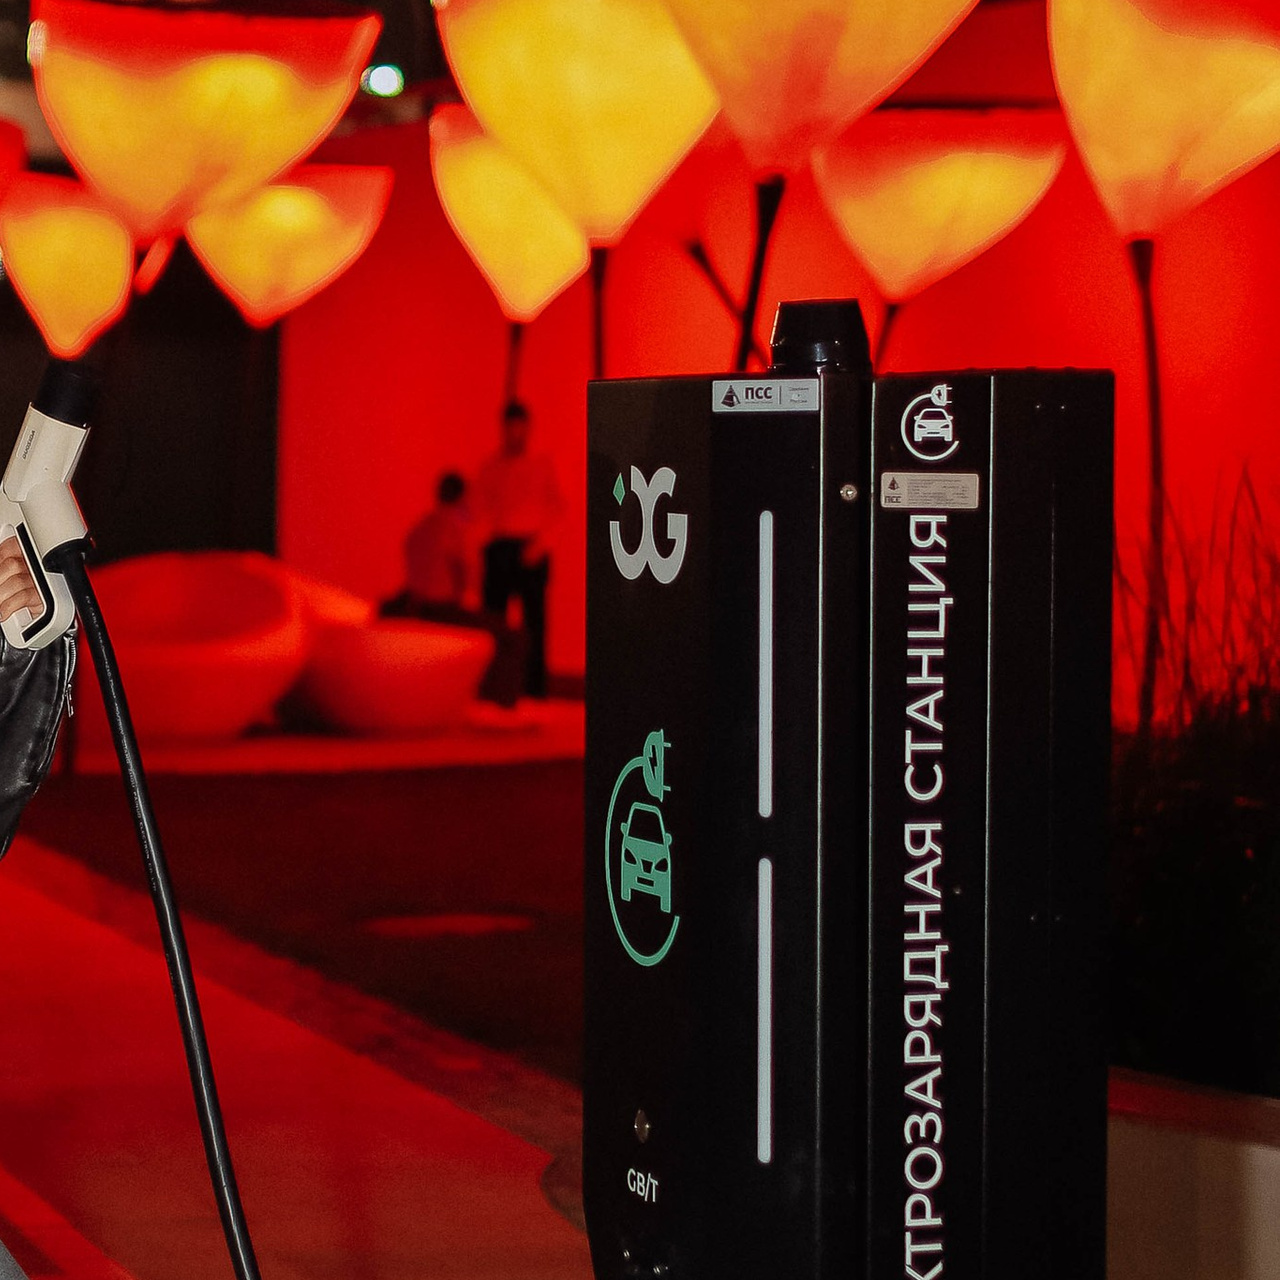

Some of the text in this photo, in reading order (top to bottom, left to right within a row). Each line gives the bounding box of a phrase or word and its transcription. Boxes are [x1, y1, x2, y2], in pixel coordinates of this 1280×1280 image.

[745, 387, 773, 400] ПСС
[904, 515, 954, 800] СТАНЦИЯ
[627, 1168, 659, 1203] GB/T
